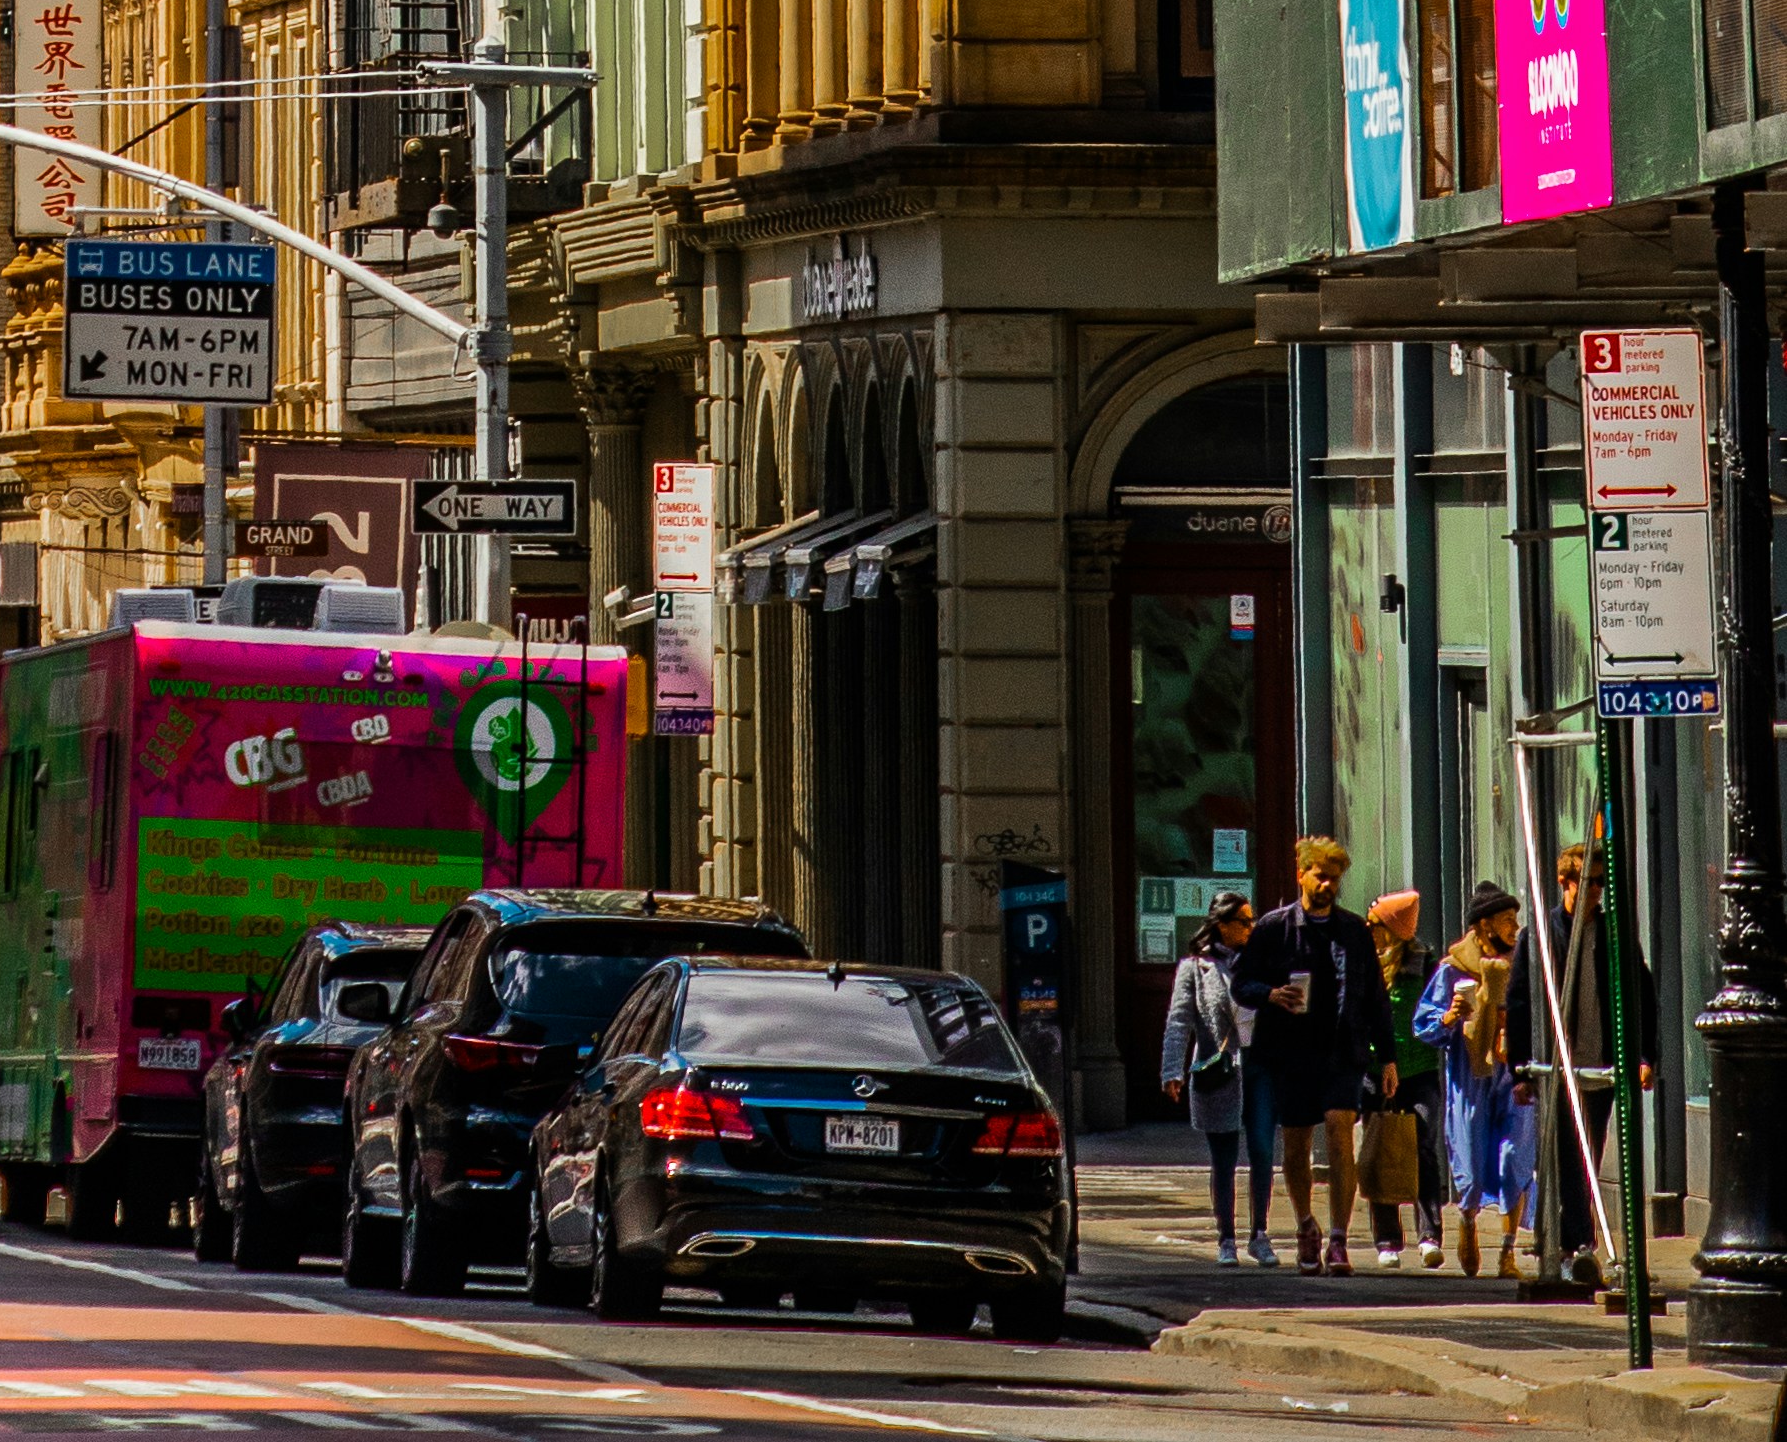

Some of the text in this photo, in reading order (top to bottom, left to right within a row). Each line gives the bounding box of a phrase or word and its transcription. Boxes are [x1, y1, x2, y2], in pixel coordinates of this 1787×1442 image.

[118, 251, 262, 277] BUS LANE
[80, 284, 260, 312] BUSES ONLY
[1594, 337, 1645, 370] 3 hour
[1625, 350, 1664, 359] metered
[1626, 363, 1660, 374] parking
[1592, 385, 1680, 402] COMMERCIAL
[1592, 404, 1695, 420] VEHICLES ONLY
[1593, 429, 1678, 443] Monday Friday
[1594, 446, 1651, 459] 7am 6pm
[659, 467, 671, 491] 3
[438, 497, 554, 518] ONE WAY
[657, 503, 702, 513] COMMERCIAL
[657, 516, 709, 527] VEHICLES ONLY
[1187, 511, 1257, 531] duane
[246, 526, 313, 545] GRAND
[1601, 515, 1653, 548] 2 hour
[1632, 527, 1673, 538] metered
[264, 545, 294, 556] STREET
[1633, 541, 1669, 553] parking
[1599, 561, 1684, 574] Monday Friday
[1600, 577, 1662, 591] 6pm 10pm
[659, 593, 670, 617] 2
[1600, 600, 1650, 614] Saturday
[1601, 615, 1663, 628] 8am 10pm
[351, 714, 390, 743] CBD
[224, 727, 306, 787] CBG
[316, 770, 374, 807] CBDA
[146, 829, 222, 864] Kings
[145, 868, 250, 897] Cookies
[272, 873, 318, 907] Dry
[324, 875, 388, 902] Herb
[144, 907, 231, 936] Potion
[235, 915, 286, 940] 420
[1027, 913, 1048, 948] P
